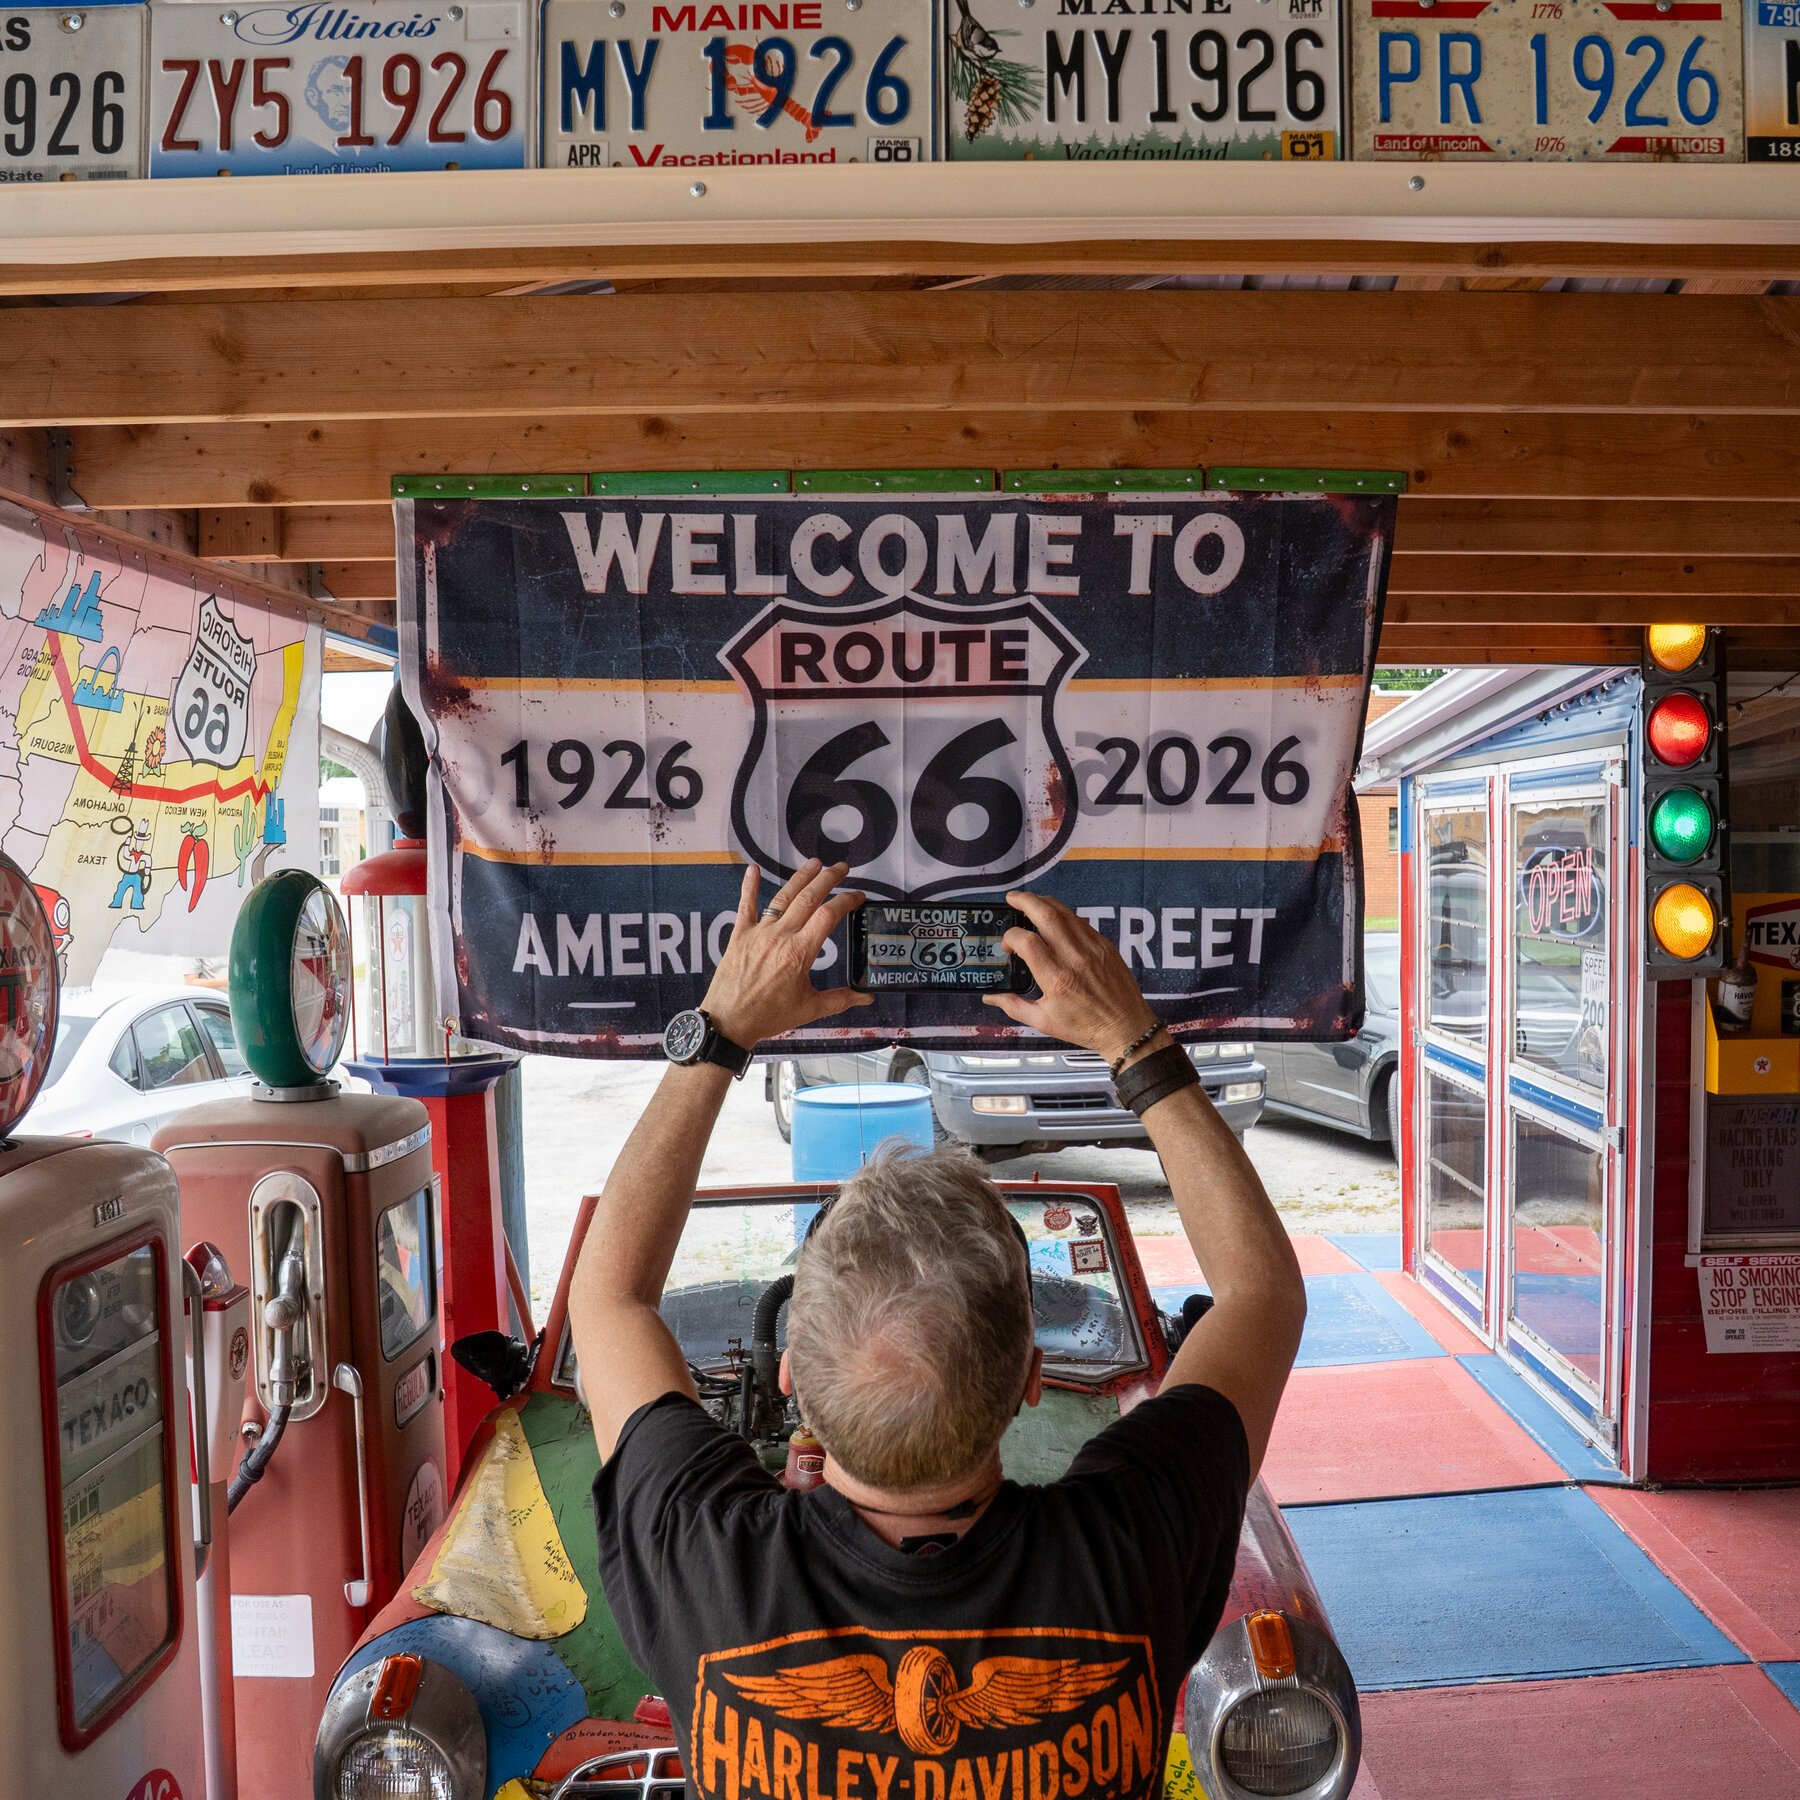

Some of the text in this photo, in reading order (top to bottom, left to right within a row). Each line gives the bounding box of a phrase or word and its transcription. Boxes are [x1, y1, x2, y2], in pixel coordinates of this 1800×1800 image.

[652, 3, 822, 32] MAINE
[1530, 3, 1563, 19] 1776
[234, 1, 442, 46] Illinois
[0, 17, 31, 51] S
[561, 36, 909, 131] MY 1926
[1379, 32, 1481, 124] PR
[1530, 34, 1719, 127] 1926
[160, 49, 513, 152] ZY5 1926
[4, 71, 124, 157] 926
[1063, 142, 1230, 161] Vacationland
[1290, 141, 1324, 156] 01
[1375, 136, 1481, 150] Land of Lincoln
[1535, 137, 1565, 152] 1976
[1646, 138, 1721, 153] ILLINOIS
[568, 144, 600, 166] APR
[628, 144, 836, 167] Vacationland
[0, 171, 43, 182] State
[285, 163, 391, 175] Land of Lincoln
[560, 511, 1245, 597] WELCOME TO
[780, 629, 1030, 685] ROUTE
[500, 739, 704, 811] 1926
[1094, 735, 1310, 806] 2026
[785, 720, 1024, 869] 66
[1528, 847, 1593, 935] OPEN
[883, 908, 994, 924] WELCOME TO
[918, 928, 959, 937] ROUTE
[1076, 906, 1277, 969] TREET
[1750, 922, 1800, 945] TEX
[870, 944, 906, 957] 1926
[918, 942, 958, 966] 66
[968, 945, 995, 957] 202
[870, 971, 928, 984] AMERICA'S
[931, 972, 957, 983] MAIN
[1585, 980, 1605, 998] LIMIT
[1720, 1127, 1797, 1147] RACING FANS
[1732, 1148, 1784, 1168] PARKING
[1743, 1169, 1773, 1188] ONLY
[1705, 1257, 1743, 1266] SELF
[1713, 1268, 1734, 1287] NO
[1710, 1288, 1746, 1308] STOP
[397, 1372, 426, 1413] REGULA
[63, 1376, 149, 1453] TEXACO
[408, 1482, 437, 1523] TEXACO
[253, 1600, 270, 1608] USE
[234, 1626, 291, 1639] ONTAIN
[241, 1644, 289, 1658] LEAD
[702, 1674, 1159, 1800] HARLEY-DAVIDSON
